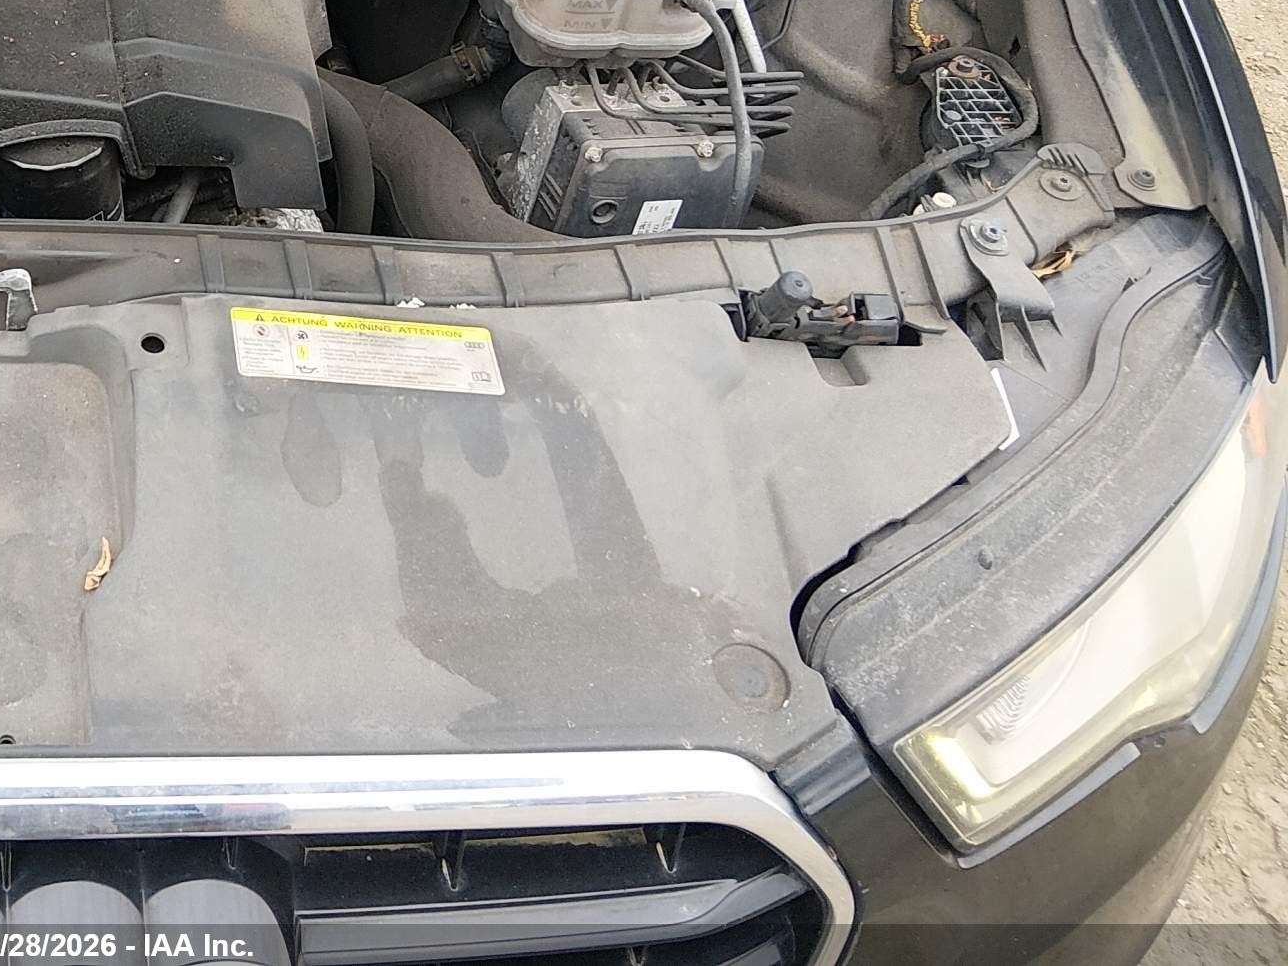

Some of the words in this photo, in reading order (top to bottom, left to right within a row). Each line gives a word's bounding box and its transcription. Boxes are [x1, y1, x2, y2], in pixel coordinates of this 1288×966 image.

[567, 0, 603, 9] MAX
[271, 315, 328, 327] ACHTUNG
[334, 321, 393, 333] WARNING
[398, 326, 463, 338] ATTENTION
